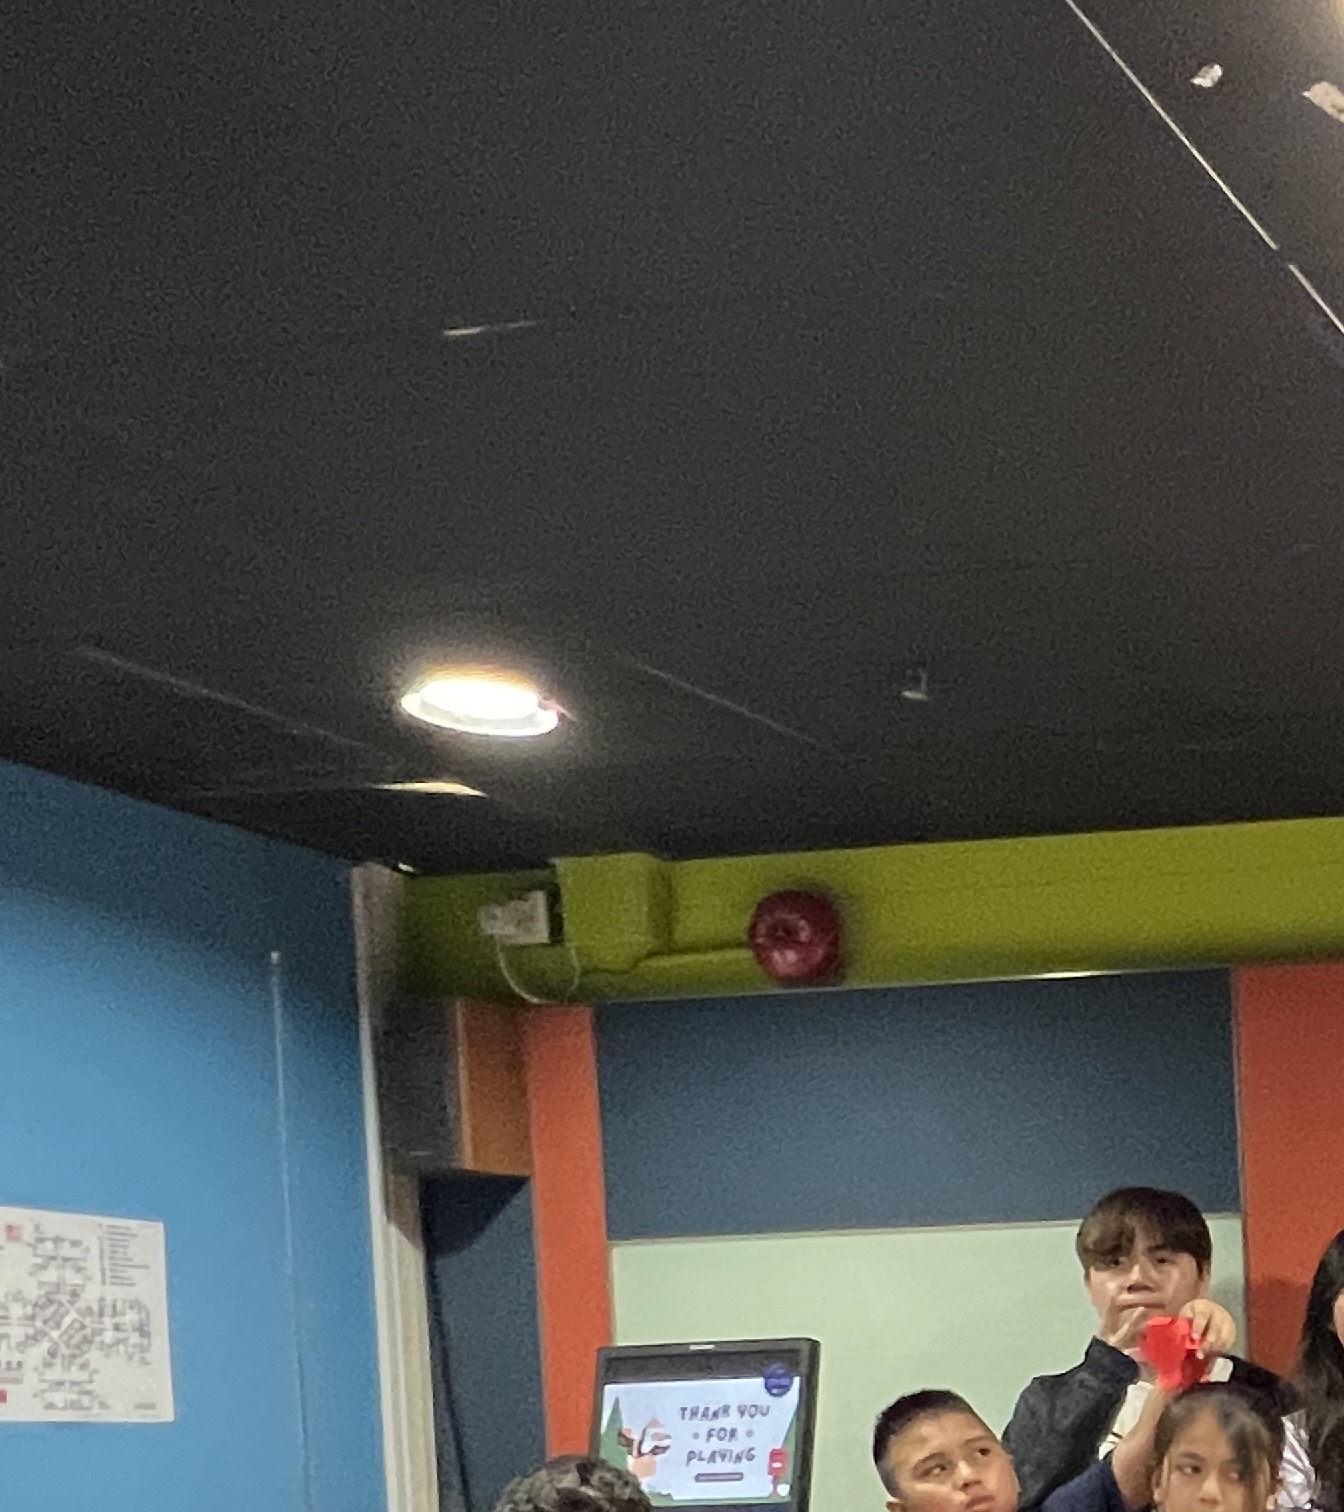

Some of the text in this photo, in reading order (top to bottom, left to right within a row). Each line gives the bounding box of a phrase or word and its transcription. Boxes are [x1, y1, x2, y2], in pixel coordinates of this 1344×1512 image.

[679, 1403, 771, 1422] THANK YOU
[704, 1426, 739, 1443] FOR
[685, 1446, 756, 1467] PLAYING
